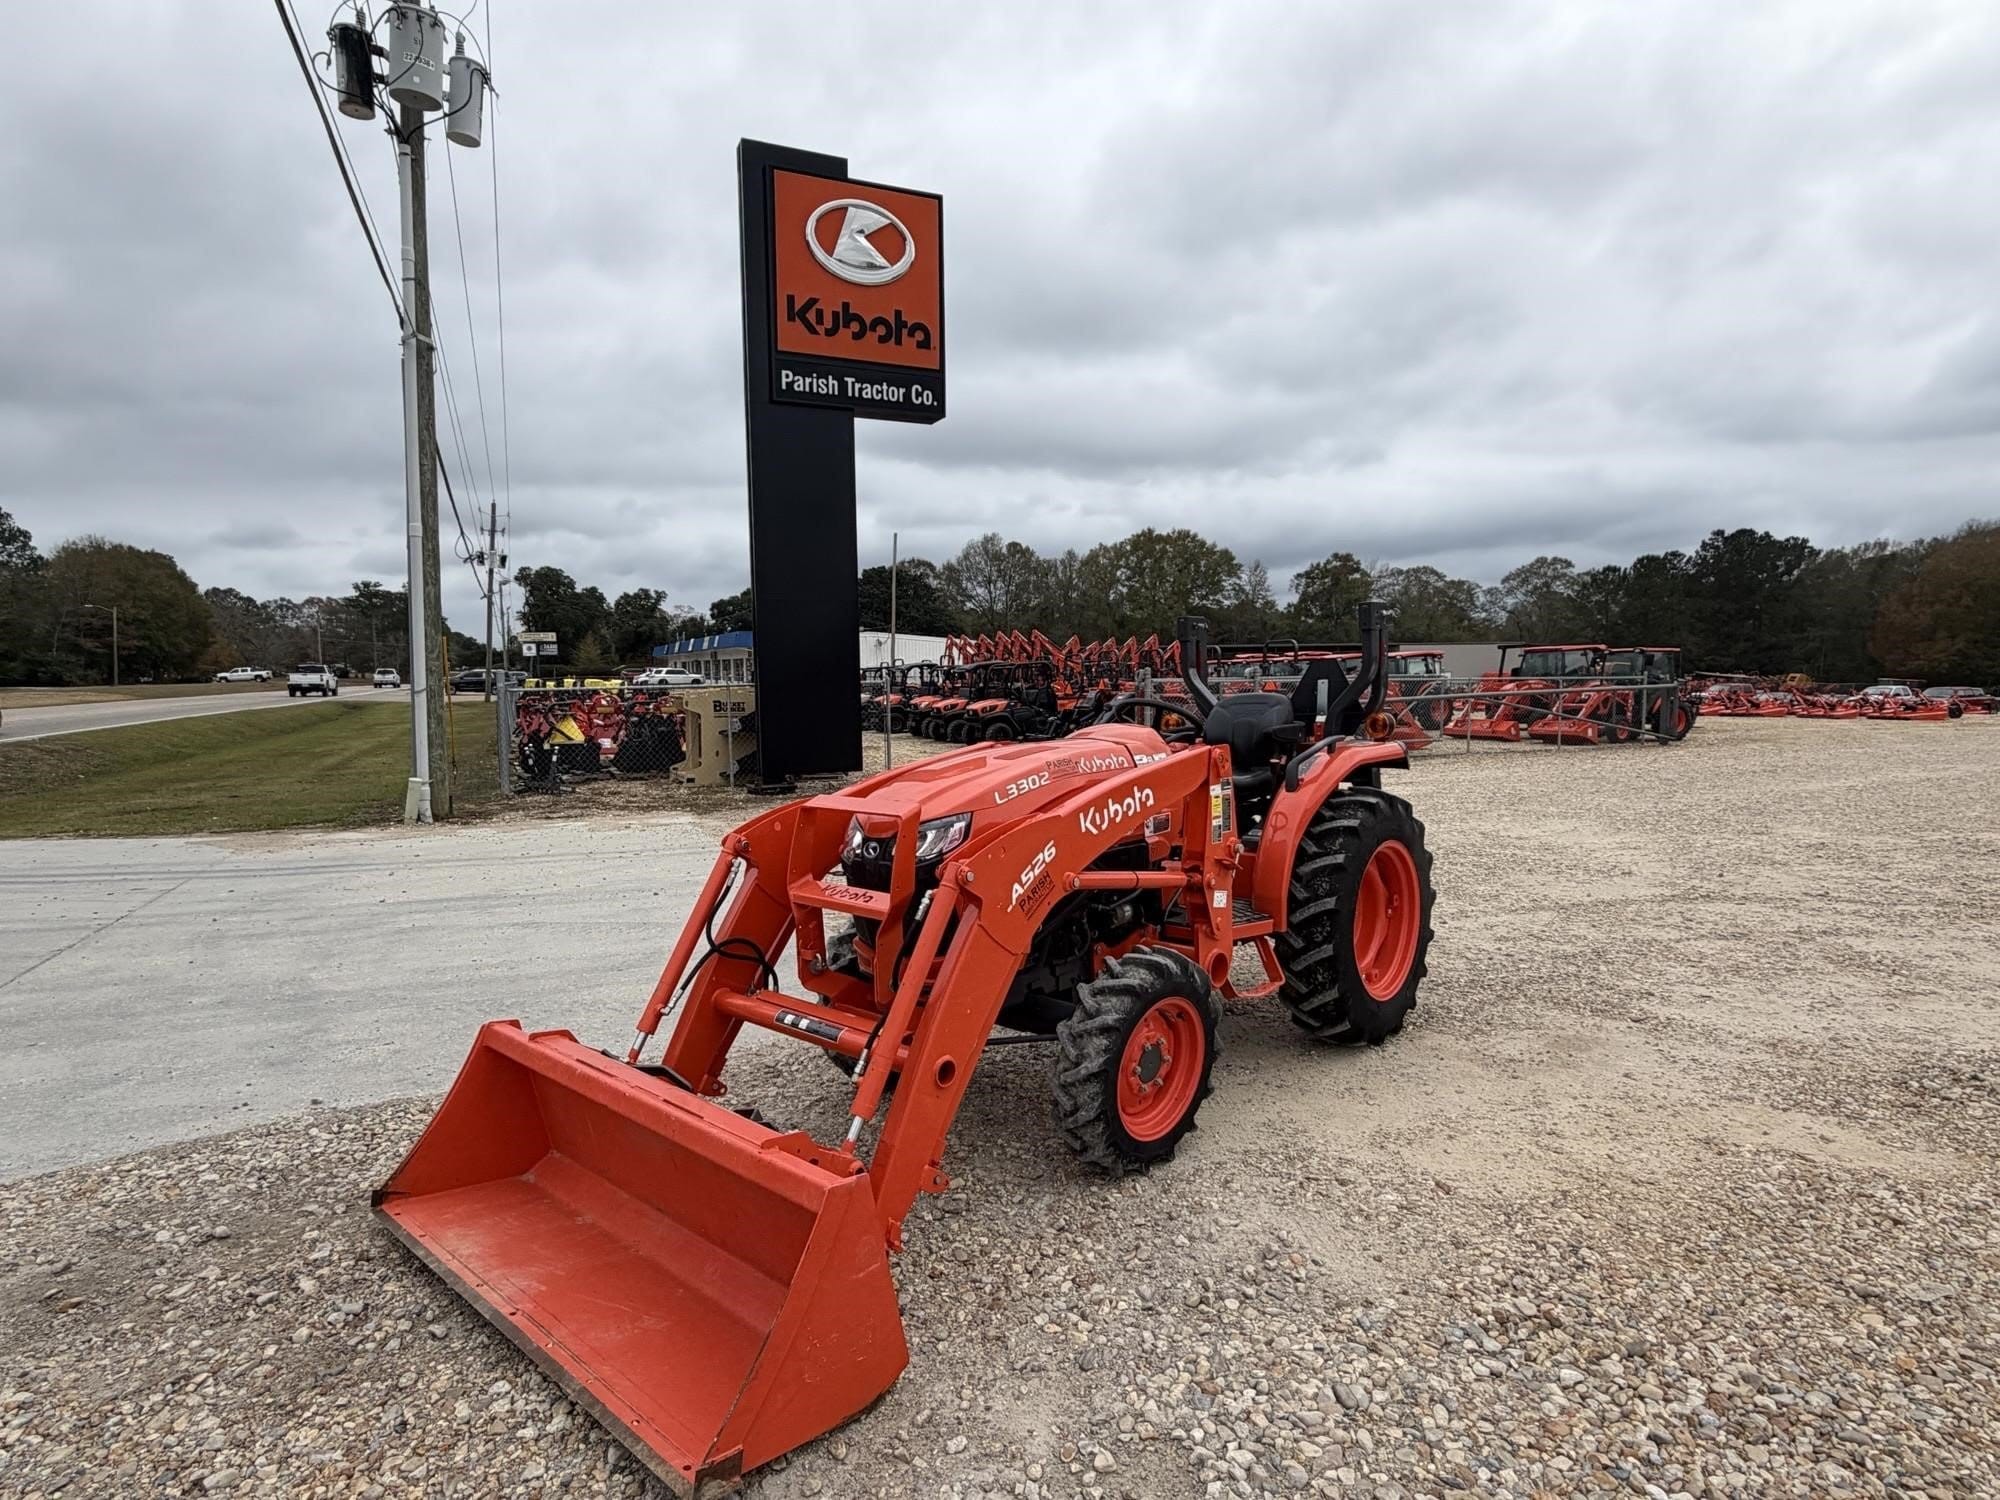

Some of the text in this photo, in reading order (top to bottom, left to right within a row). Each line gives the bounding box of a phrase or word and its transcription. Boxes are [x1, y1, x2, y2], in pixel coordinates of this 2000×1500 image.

[786, 293, 932, 351] Kubota
[781, 369, 938, 406] Parish Tractor Co.
[1079, 753, 1128, 774] Kubota
[994, 771, 1051, 805] L3302
[1079, 785, 1154, 835] Kubota
[821, 884, 874, 903] Kubota
[1018, 870, 1052, 912] PARISH
